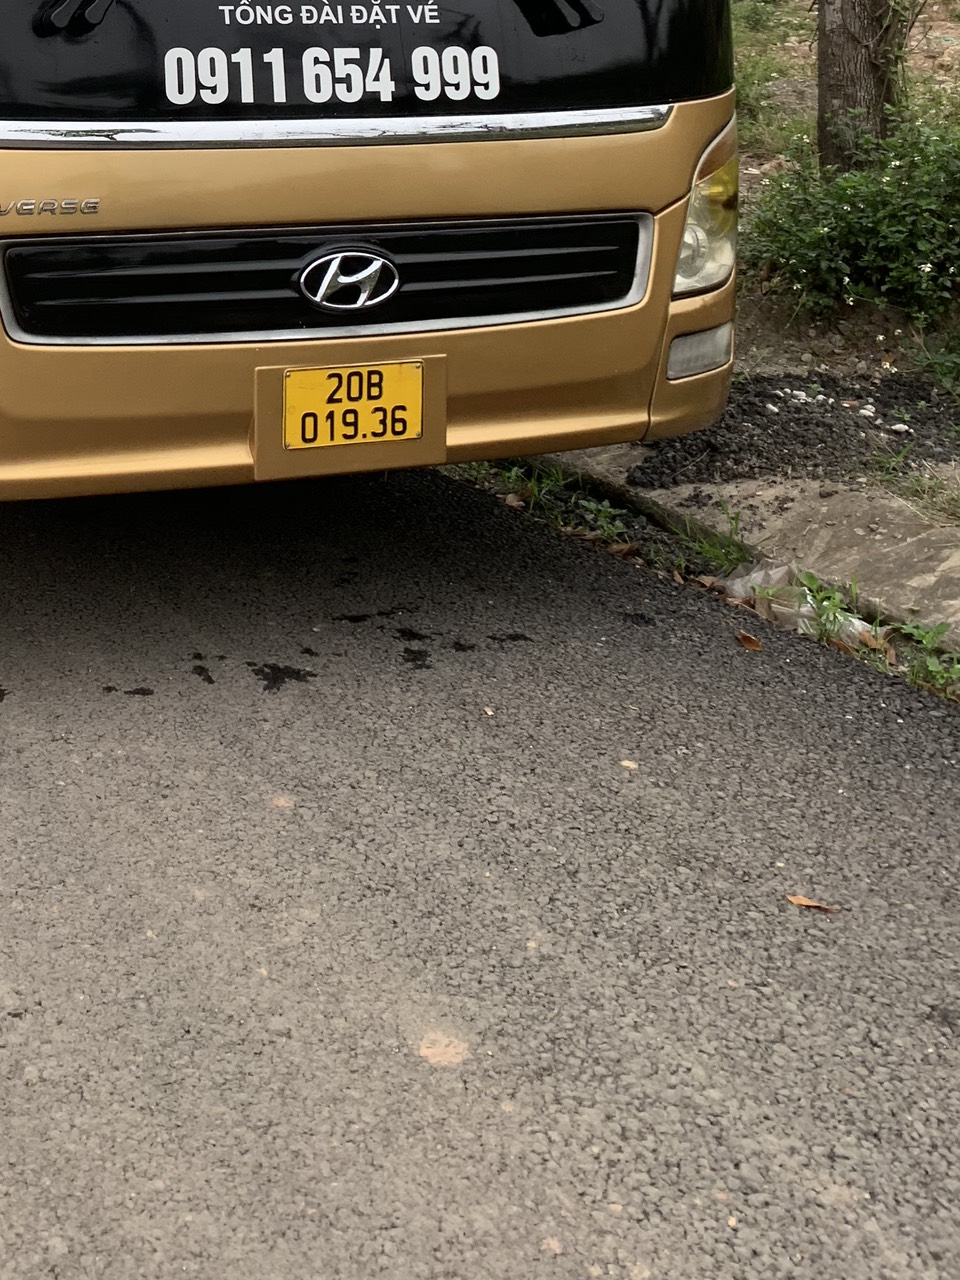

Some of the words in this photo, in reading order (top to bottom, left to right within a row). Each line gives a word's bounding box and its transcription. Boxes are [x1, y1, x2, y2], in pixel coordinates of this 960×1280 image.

[300, 0, 343, 24] ĐÀI
[350, 0, 401, 29] ĐẶT
[406, 0, 440, 24] VÉ
[164, 47, 287, 105] 0911
[302, 47, 396, 103] 654
[411, 45, 501, 101] 999
[326, 370, 383, 404] 20B
[301, 405, 407, 443] 019.36
